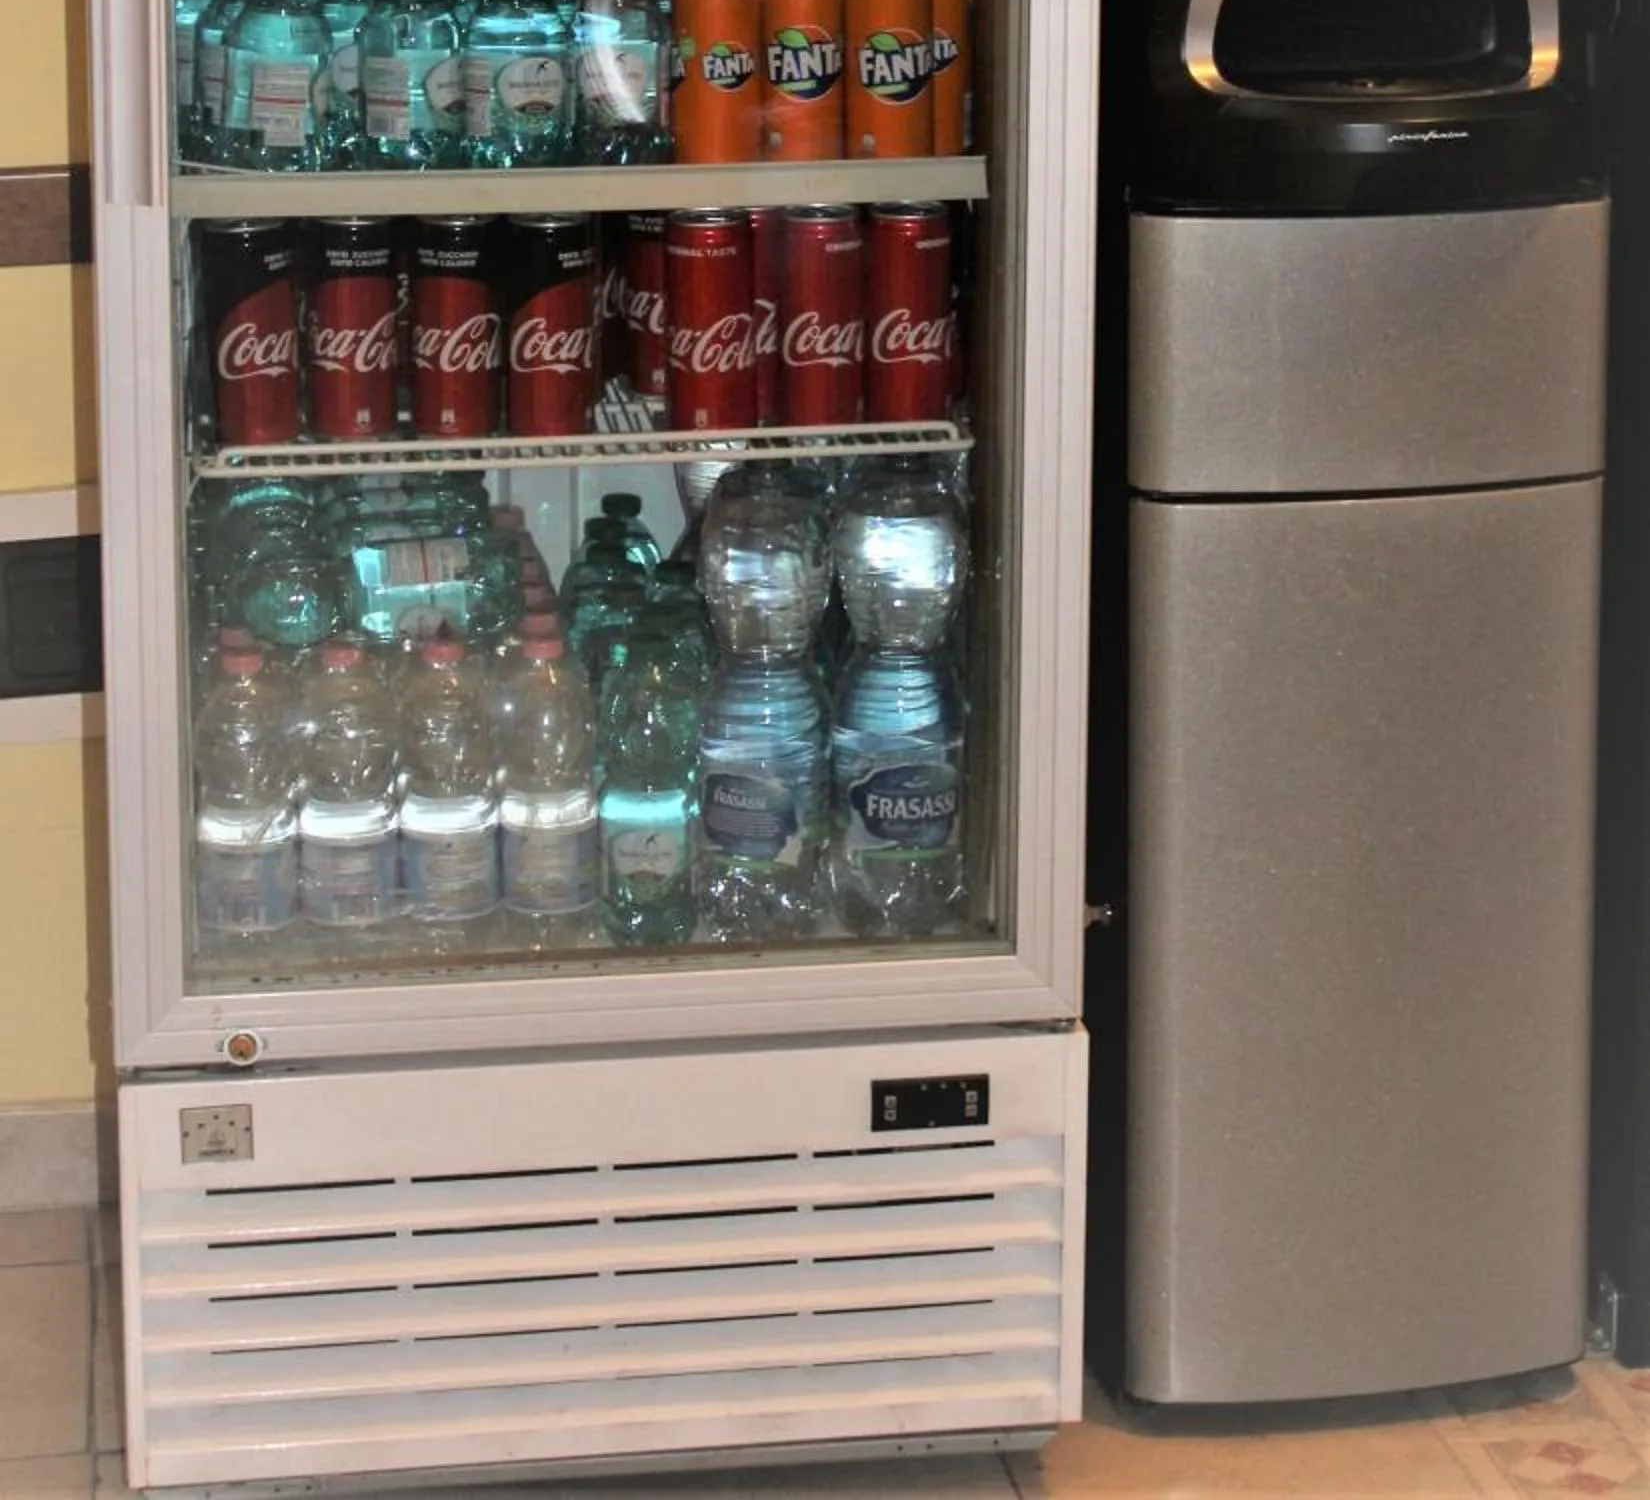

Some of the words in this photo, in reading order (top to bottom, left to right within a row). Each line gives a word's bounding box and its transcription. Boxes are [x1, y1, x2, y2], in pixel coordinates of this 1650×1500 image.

[702, 51, 755, 80] FANTA
[767, 42, 842, 82] FANTA
[858, 42, 933, 85] FANTA
